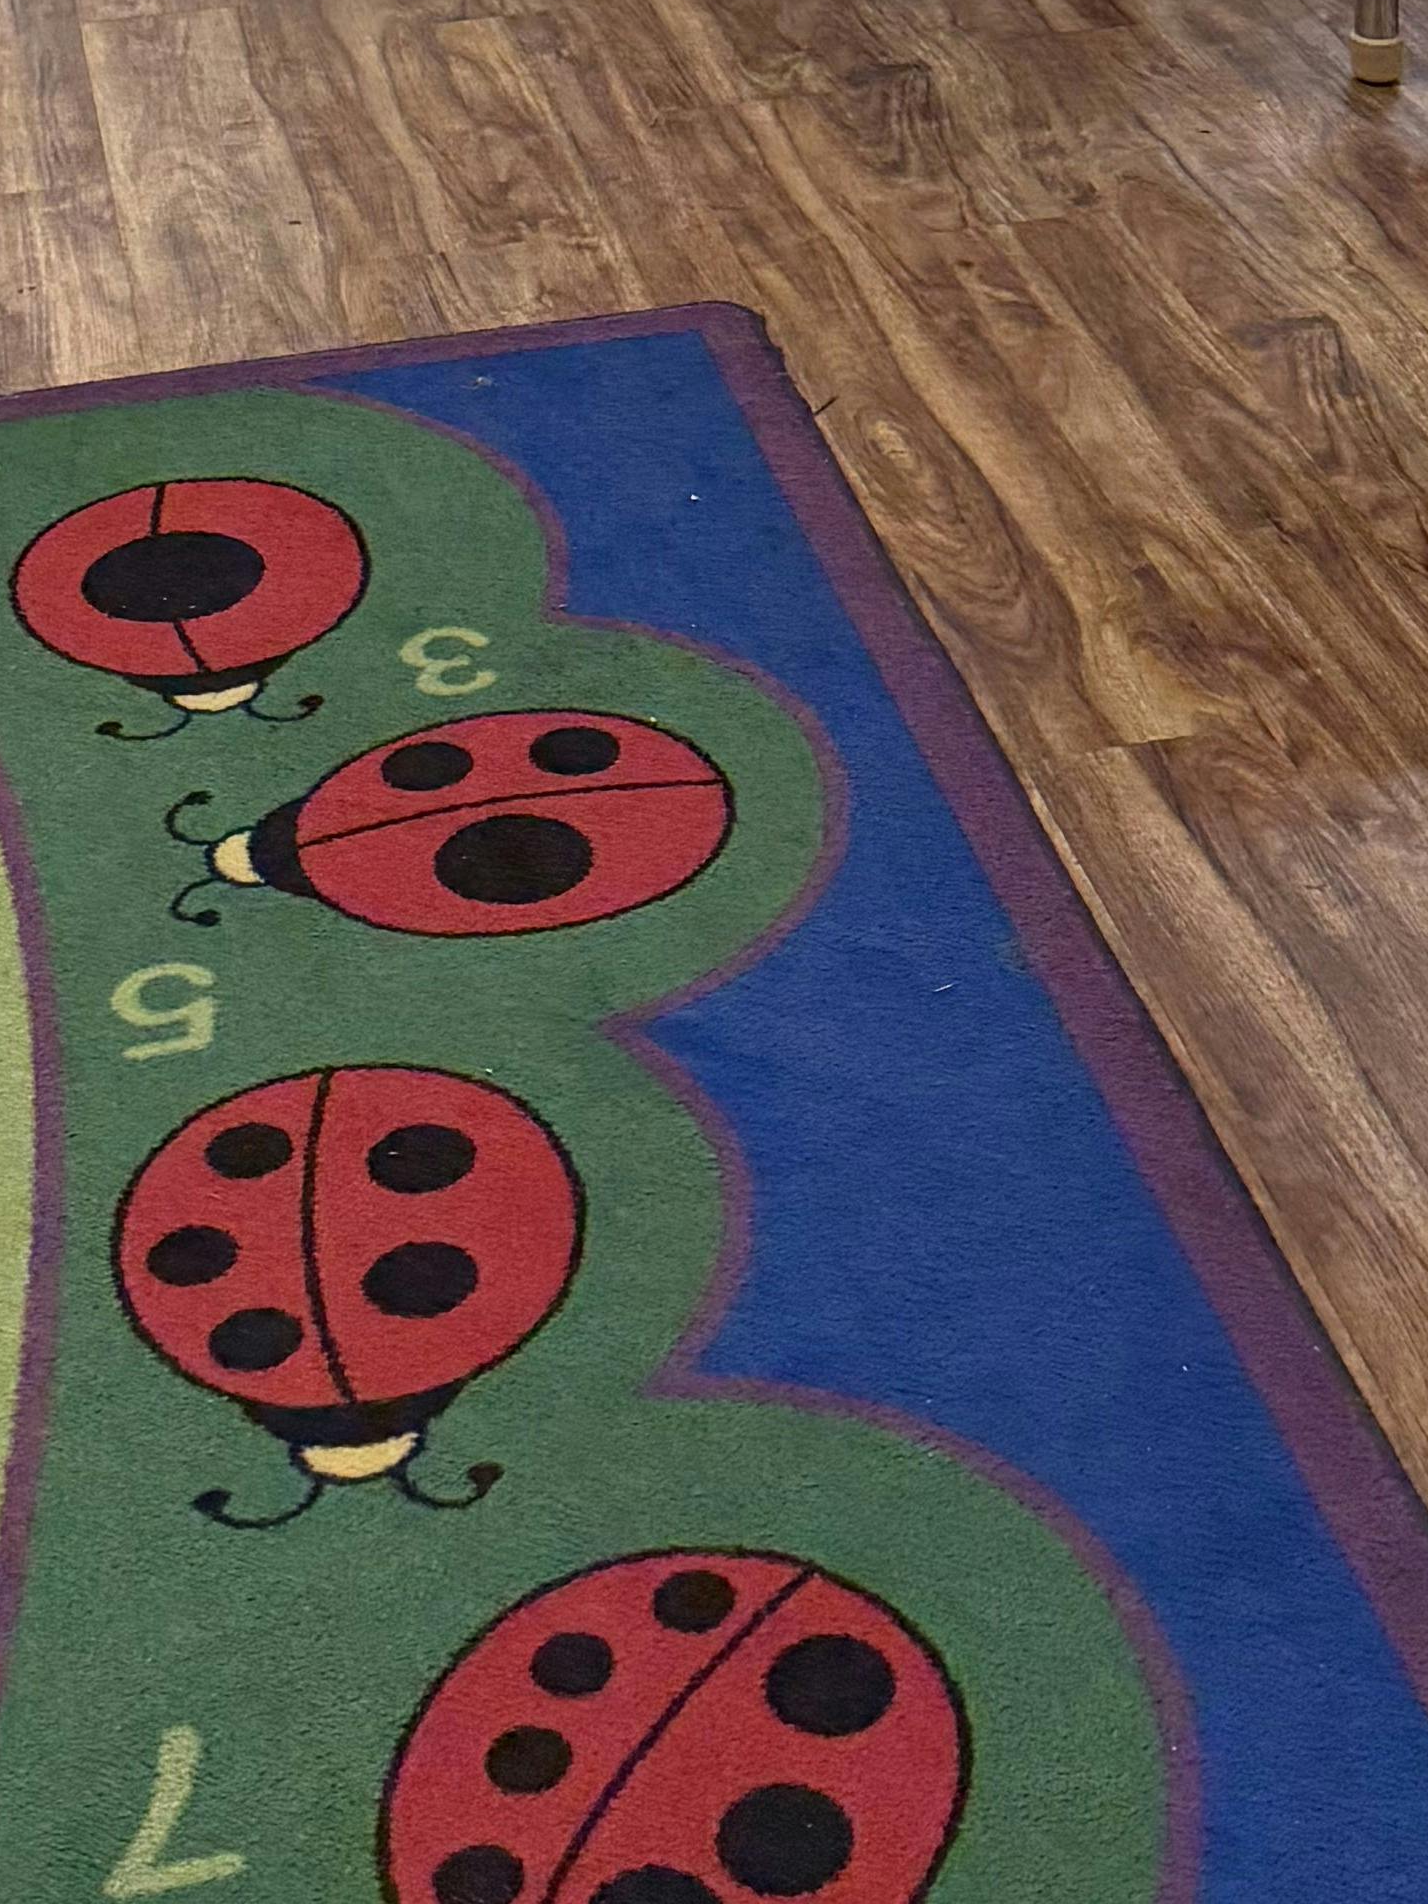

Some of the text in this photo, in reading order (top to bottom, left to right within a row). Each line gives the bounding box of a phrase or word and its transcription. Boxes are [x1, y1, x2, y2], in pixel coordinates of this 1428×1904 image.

[397, 626, 499, 697] 3
[110, 962, 219, 1062] 5
[102, 1726, 248, 1899] 7
